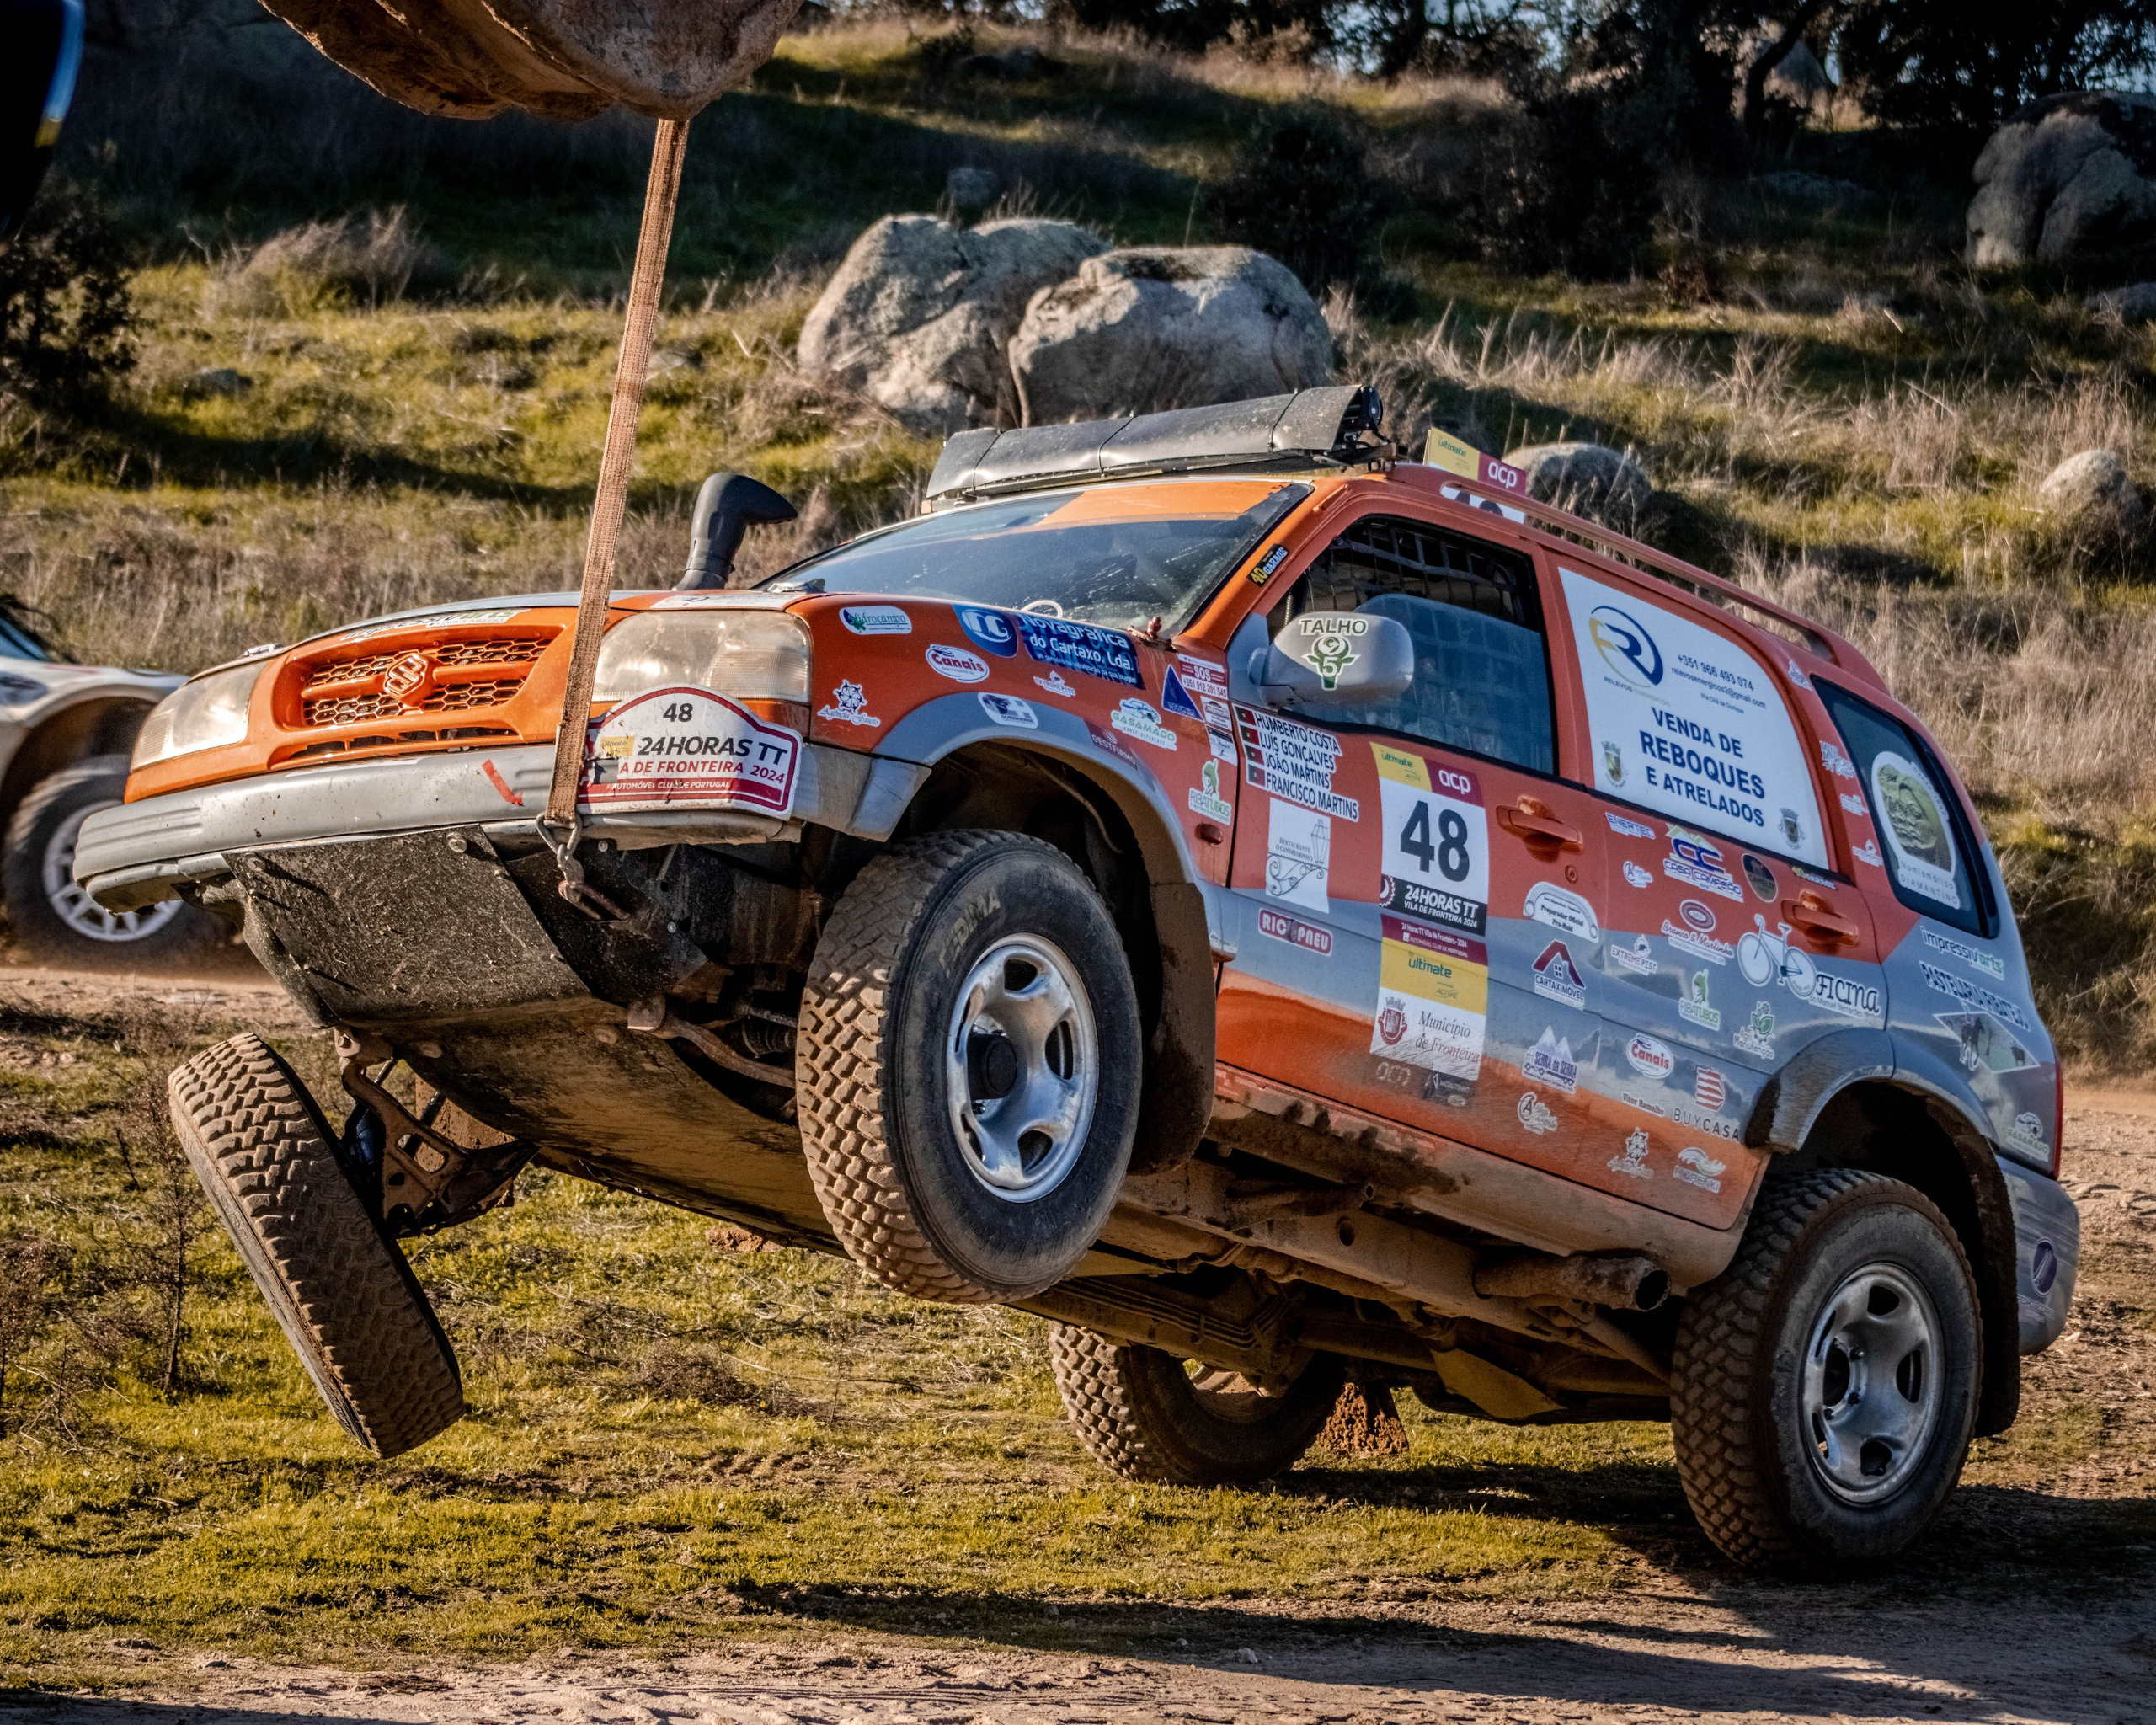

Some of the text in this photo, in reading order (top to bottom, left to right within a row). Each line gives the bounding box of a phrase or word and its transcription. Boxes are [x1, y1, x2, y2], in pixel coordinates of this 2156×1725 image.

[1438, 440, 1466, 457] ultimate
[1488, 462, 1517, 489] acp
[1263, 547, 1289, 574] GARAGE
[1018, 614, 1129, 649] Novagráfica
[1300, 619, 1367, 632] TALHO
[931, 653, 985, 672] Canais
[1030, 633, 1047, 649] do
[1107, 653, 1134, 671] Lda.
[1193, 665, 1211, 681] SOS
[1604, 676, 1633, 692] RELEVOS
[1678, 654, 1754, 692] +351 966 493 074
[1196, 681, 1206, 691] 912
[1206, 684, 1216, 693] 201
[662, 702, 693, 723] 48
[1113, 712, 1175, 741] GASAMADO
[1255, 713, 1308, 743] HUMBERTO
[1309, 729, 1341, 754] COSTA
[1651, 707, 1743, 758] VENDA DE
[638, 736, 787, 766] 24HORAS TT
[1259, 731, 1279, 753] LUÍS
[1281, 740, 1335, 771] GONÇALVES
[1381, 751, 1413, 768] ultimate
[1639, 729, 1765, 799] REBOQUES
[633, 761, 653, 773] DE
[657, 761, 744, 773] FRONTEIRA
[750, 765, 785, 784] 2024
[690, 780, 730, 788] PORTUGAL
[1265, 752, 1330, 790] JOÃO MARTINS
[1438, 769, 1471, 795] acp
[1190, 790, 1230, 817] RIBATUBOS
[1266, 772, 1358, 820] FRANCISCO MARTINS
[1646, 766, 1764, 827] E ATRELADOS
[1608, 814, 1654, 838] ENERTEC
[1400, 800, 1470, 883] 48
[1663, 860, 1692, 878] CASA
[1404, 884, 1478, 920] 24HORAS TT
[1404, 900, 1477, 928] VILA DE FRONTEIRA 2024
[1540, 904, 1568, 919] Preparador
[1662, 921, 1689, 940] Branco
[1690, 932, 1696, 942] &
[1698, 933, 1733, 956] Martinho
[1447, 947, 1468, 958] PORTUGAL
[1408, 956, 1452, 978] ultimate
[1435, 988, 1458, 999] ACTIVE
[1535, 975, 1583, 1001] CARTAXIMÓVEL
[1418, 1010, 1470, 1039] Município
[1680, 1000, 1719, 1024] RIBATUBOS
[1415, 1033, 1480, 1065] de Fronteira
[1631, 1044, 1669, 1069] Canais
[1534, 1051, 1552, 1069] SERRA
[1560, 1060, 1577, 1079] SERRA
[1622, 1093, 1637, 1106] Vitor
